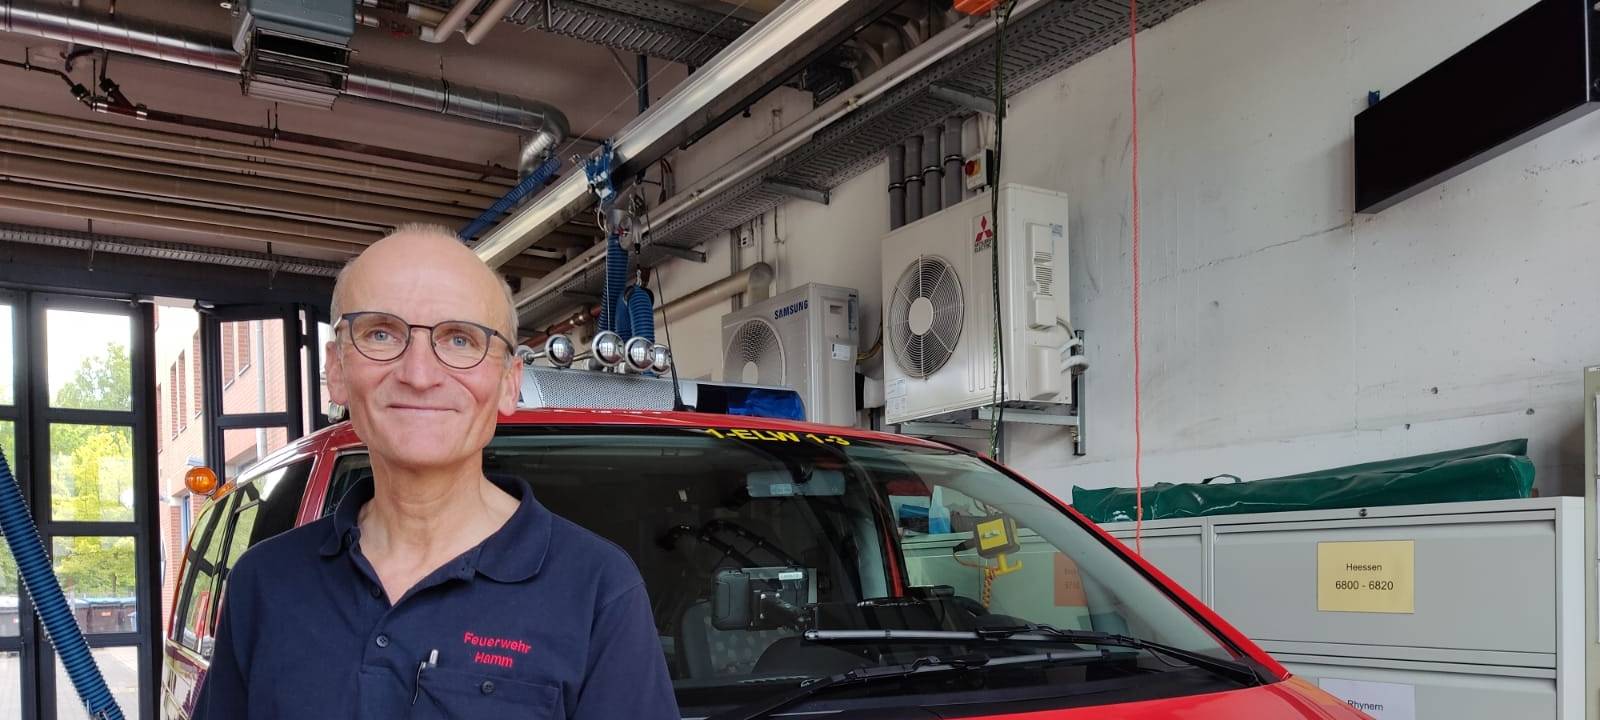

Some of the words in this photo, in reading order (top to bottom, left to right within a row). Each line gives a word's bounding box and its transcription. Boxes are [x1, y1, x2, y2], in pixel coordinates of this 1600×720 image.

[774, 300, 809, 320] SAMSUNG
[705, 428, 800, 442] 1-ELW
[806, 433, 850, 446] 1-3
[1345, 563, 1383, 571] Heessen
[1335, 580, 1360, 590] 6800
[1368, 580, 1394, 591] 6820
[463, 631, 532, 654] Feuerwehr
[474, 651, 513, 668] Hamm
